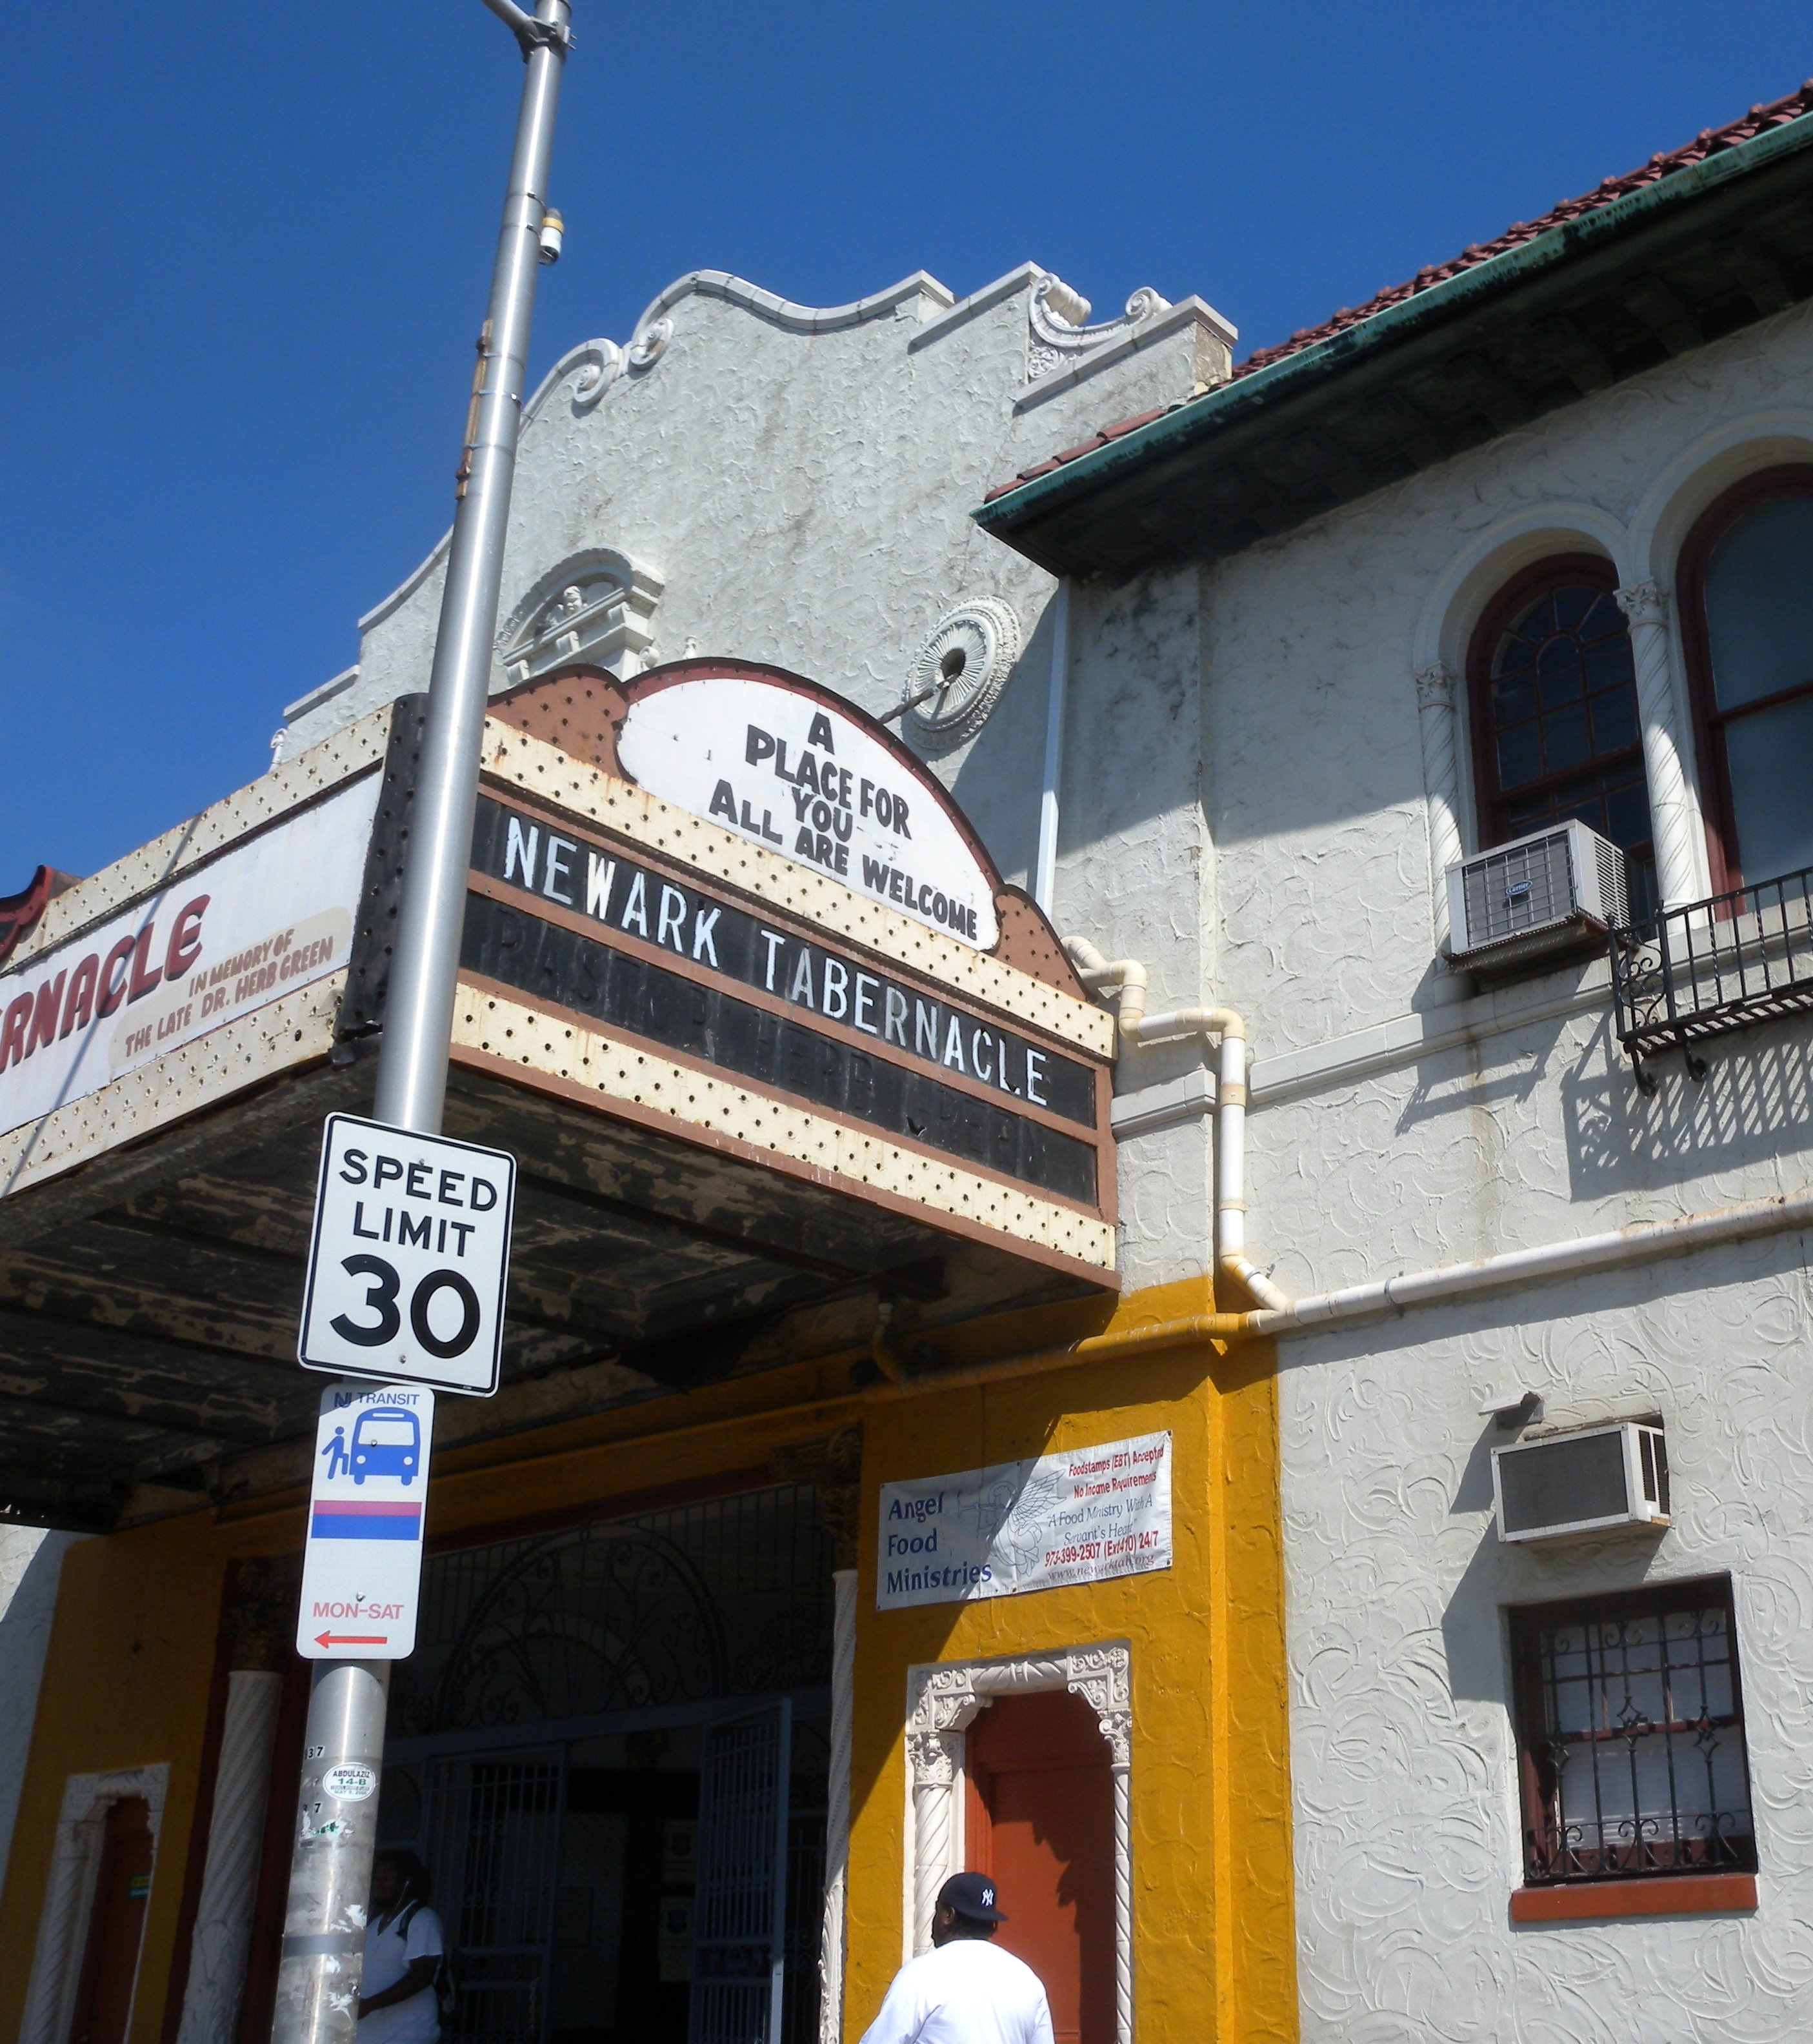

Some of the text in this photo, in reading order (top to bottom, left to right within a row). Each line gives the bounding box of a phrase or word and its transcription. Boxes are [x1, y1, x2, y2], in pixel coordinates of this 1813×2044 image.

[807, 712, 834, 756] A
[745, 724, 912, 839] PLACE FOR
[793, 785, 853, 843] YOU
[708, 780, 978, 941] ALL ARE WELCOME
[0, 894, 210, 1075] RNACLE
[188, 928, 295, 997] IN MEMORY OF
[505, 817, 1049, 1107] NEWARK TABERNACLE
[125, 936, 334, 1057] THE LATE DR. HERB GREEN
[339, 1148, 497, 1212] SPEED
[353, 1201, 476, 1257] LIMIT
[330, 1254, 481, 1359] 30
[334, 1392, 420, 1408] NJ TRANSIT
[1068, 1444, 1165, 1477] Foodstamps (EBT) Accepted
[1074, 1470, 1157, 1499] No Income Requirements
[888, 1492, 944, 1523] Angel
[1059, 1508, 1083, 1526] Food
[1126, 1498, 1144, 1512] With
[1145, 1494, 1152, 1508] A
[887, 1527, 937, 1557] Food
[1139, 1530, 1159, 1549] 24/7
[886, 1560, 992, 1594] Ministries
[313, 1602, 405, 1620] MON-SAT
